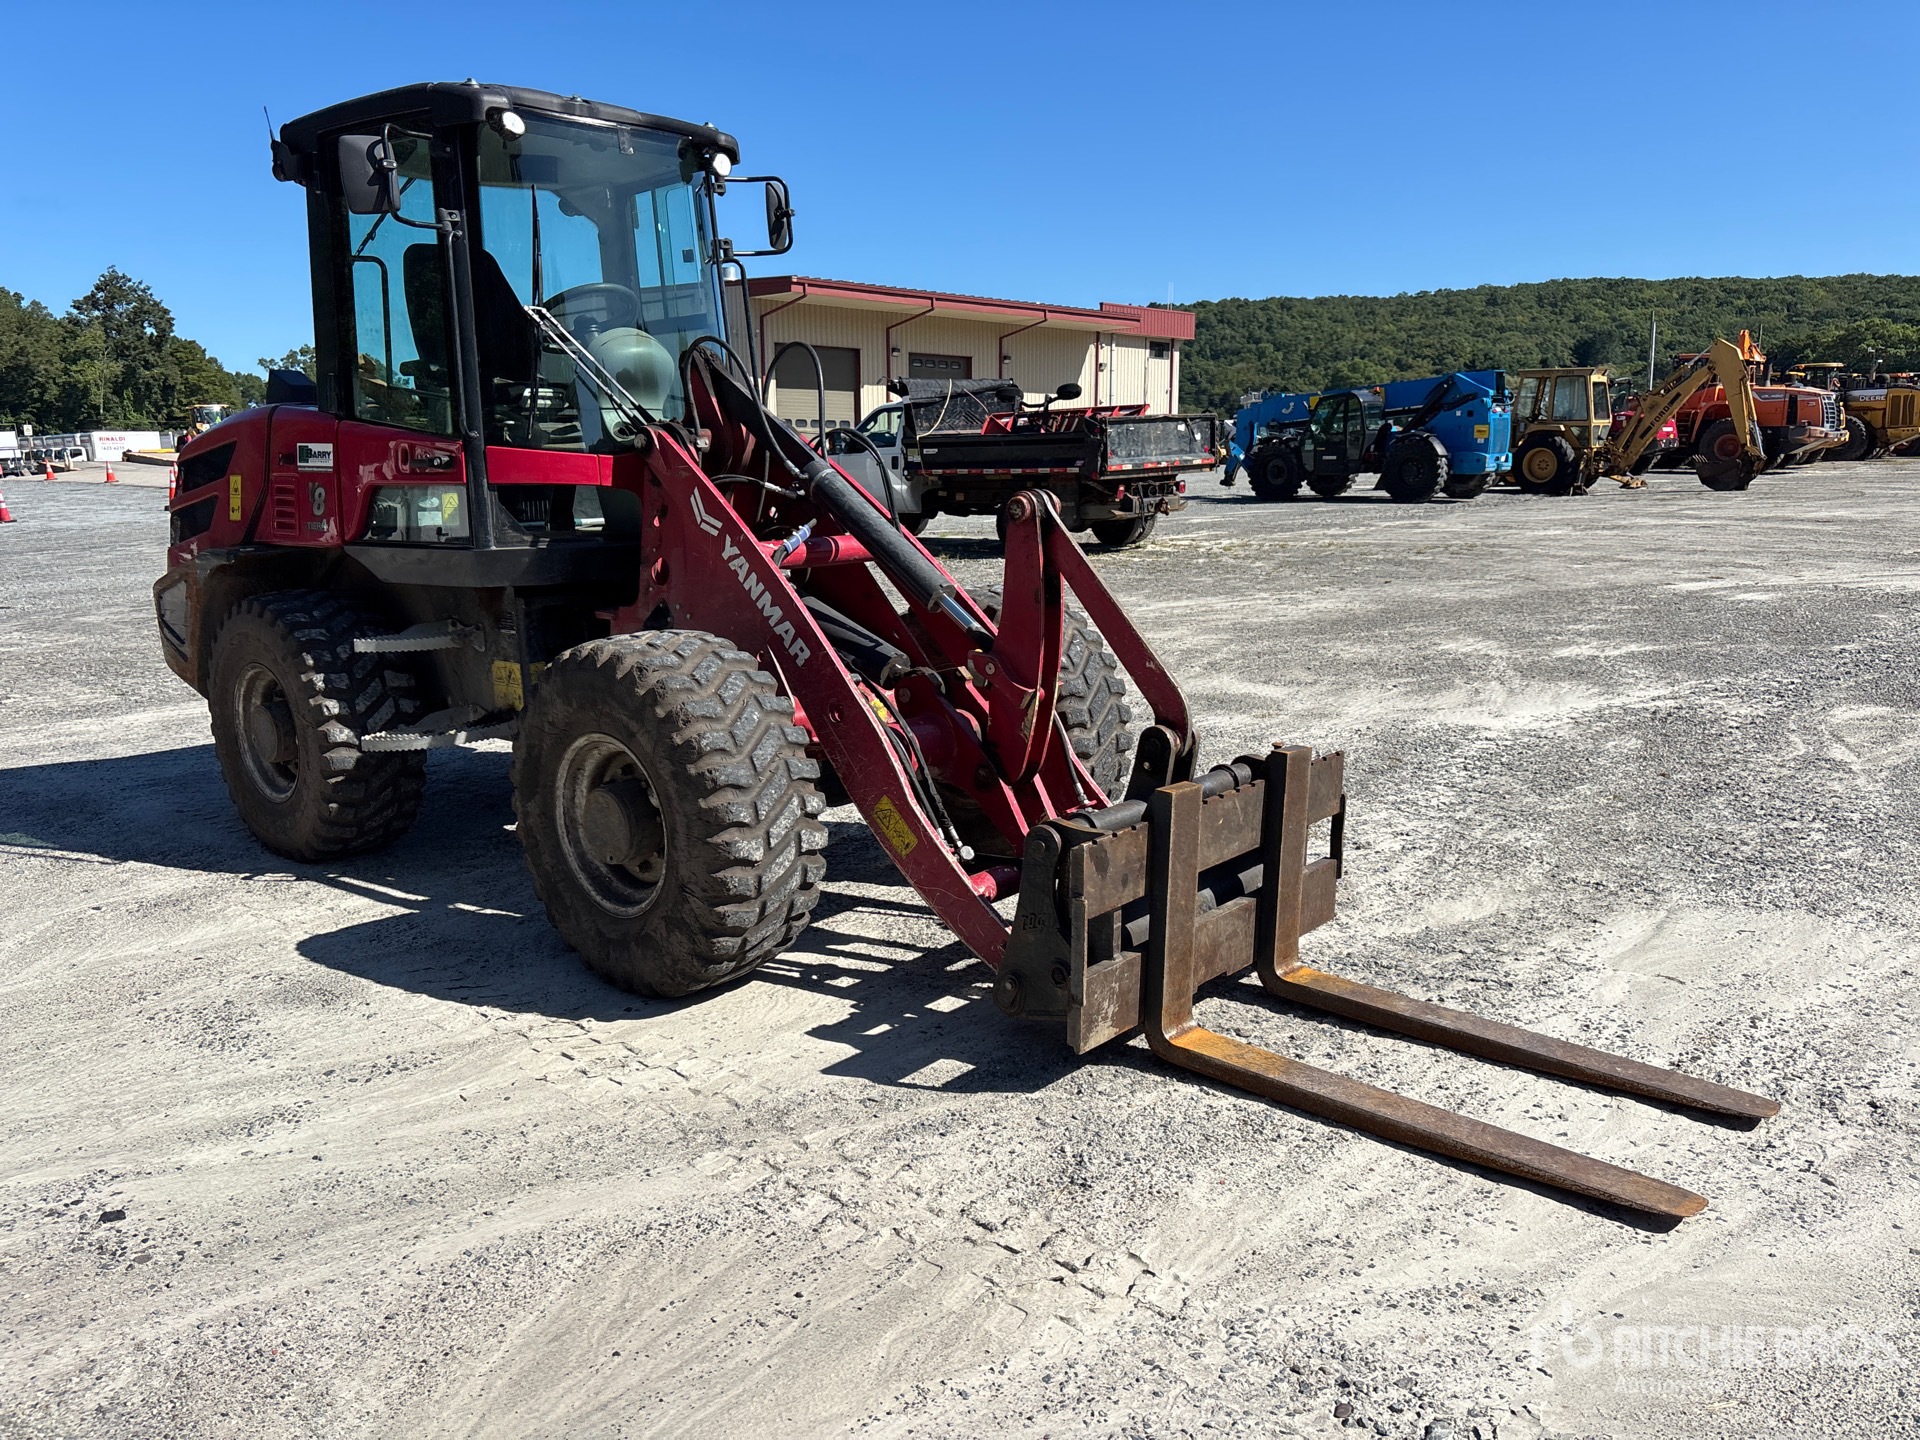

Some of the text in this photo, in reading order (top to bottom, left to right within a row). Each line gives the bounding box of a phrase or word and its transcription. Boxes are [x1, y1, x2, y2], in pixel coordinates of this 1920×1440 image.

[1650, 405, 1671, 428] FORD
[305, 448, 331, 458] BARRY
[721, 534, 812, 667] YANMAR
